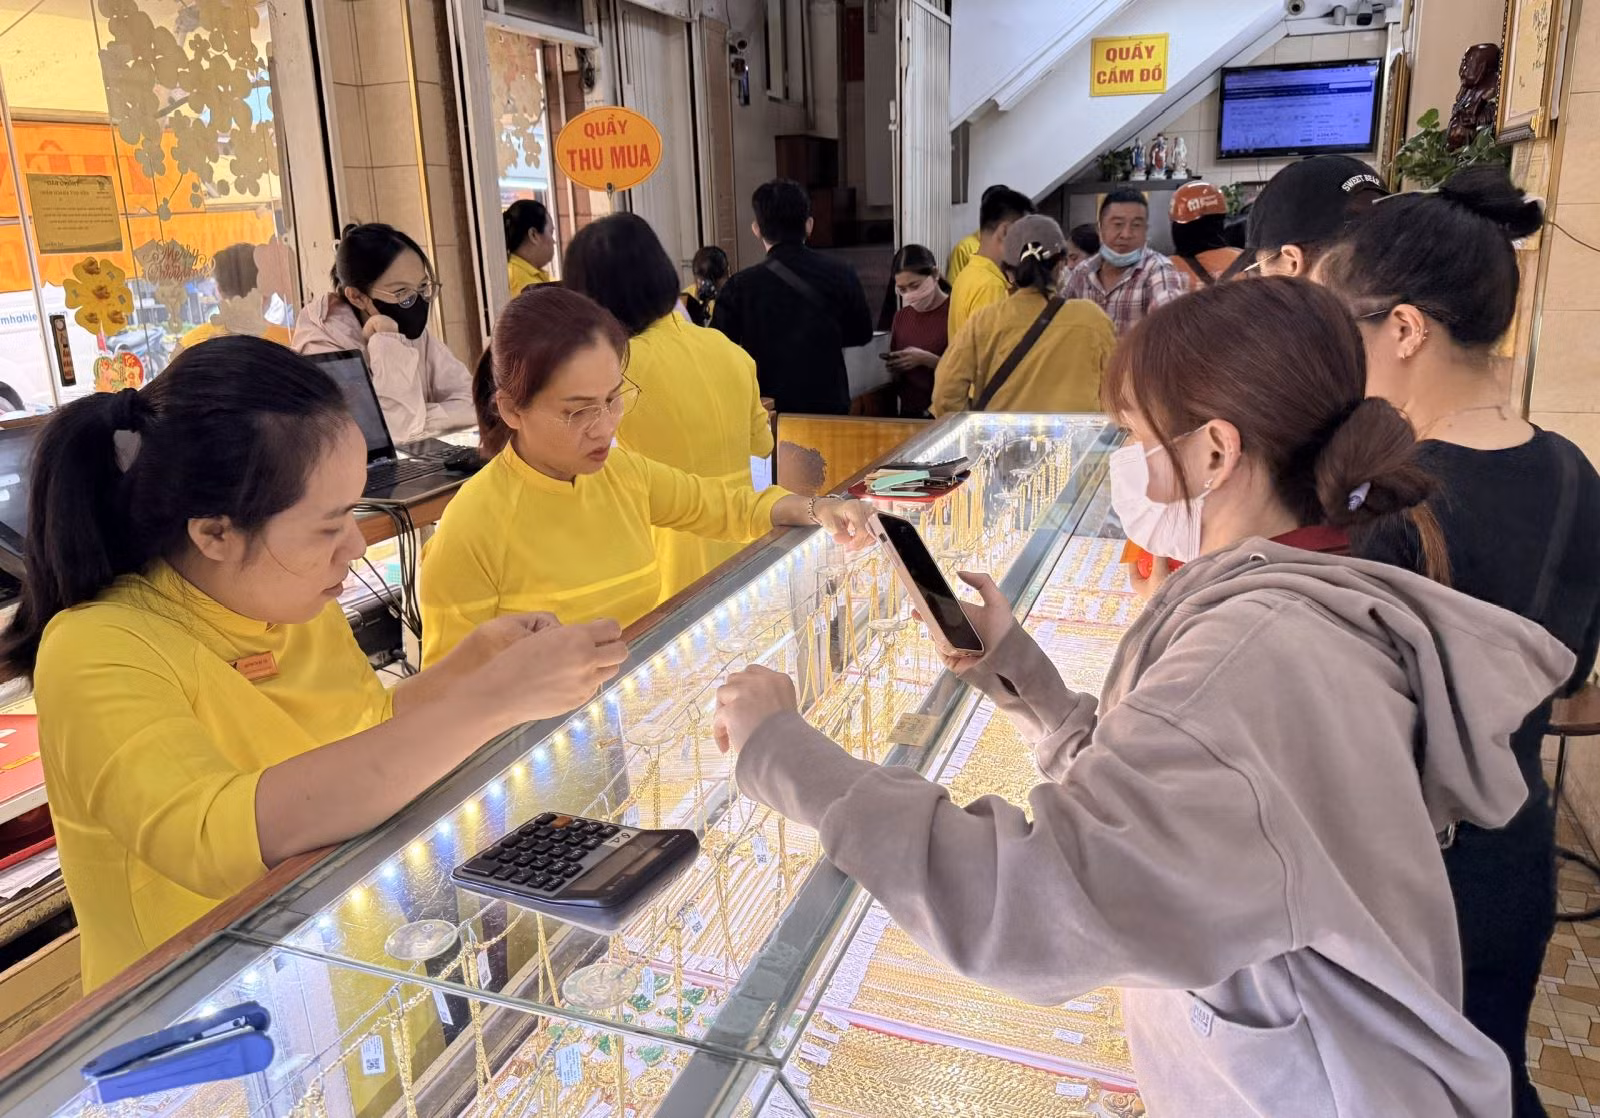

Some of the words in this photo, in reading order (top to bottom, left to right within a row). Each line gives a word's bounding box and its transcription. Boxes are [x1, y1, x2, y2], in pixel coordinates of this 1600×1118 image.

[583, 114, 627, 139] QUẦY
[566, 147, 604, 172] THU
[609, 143, 652, 170] MUA
[1341, 174, 1365, 191] SWEET
